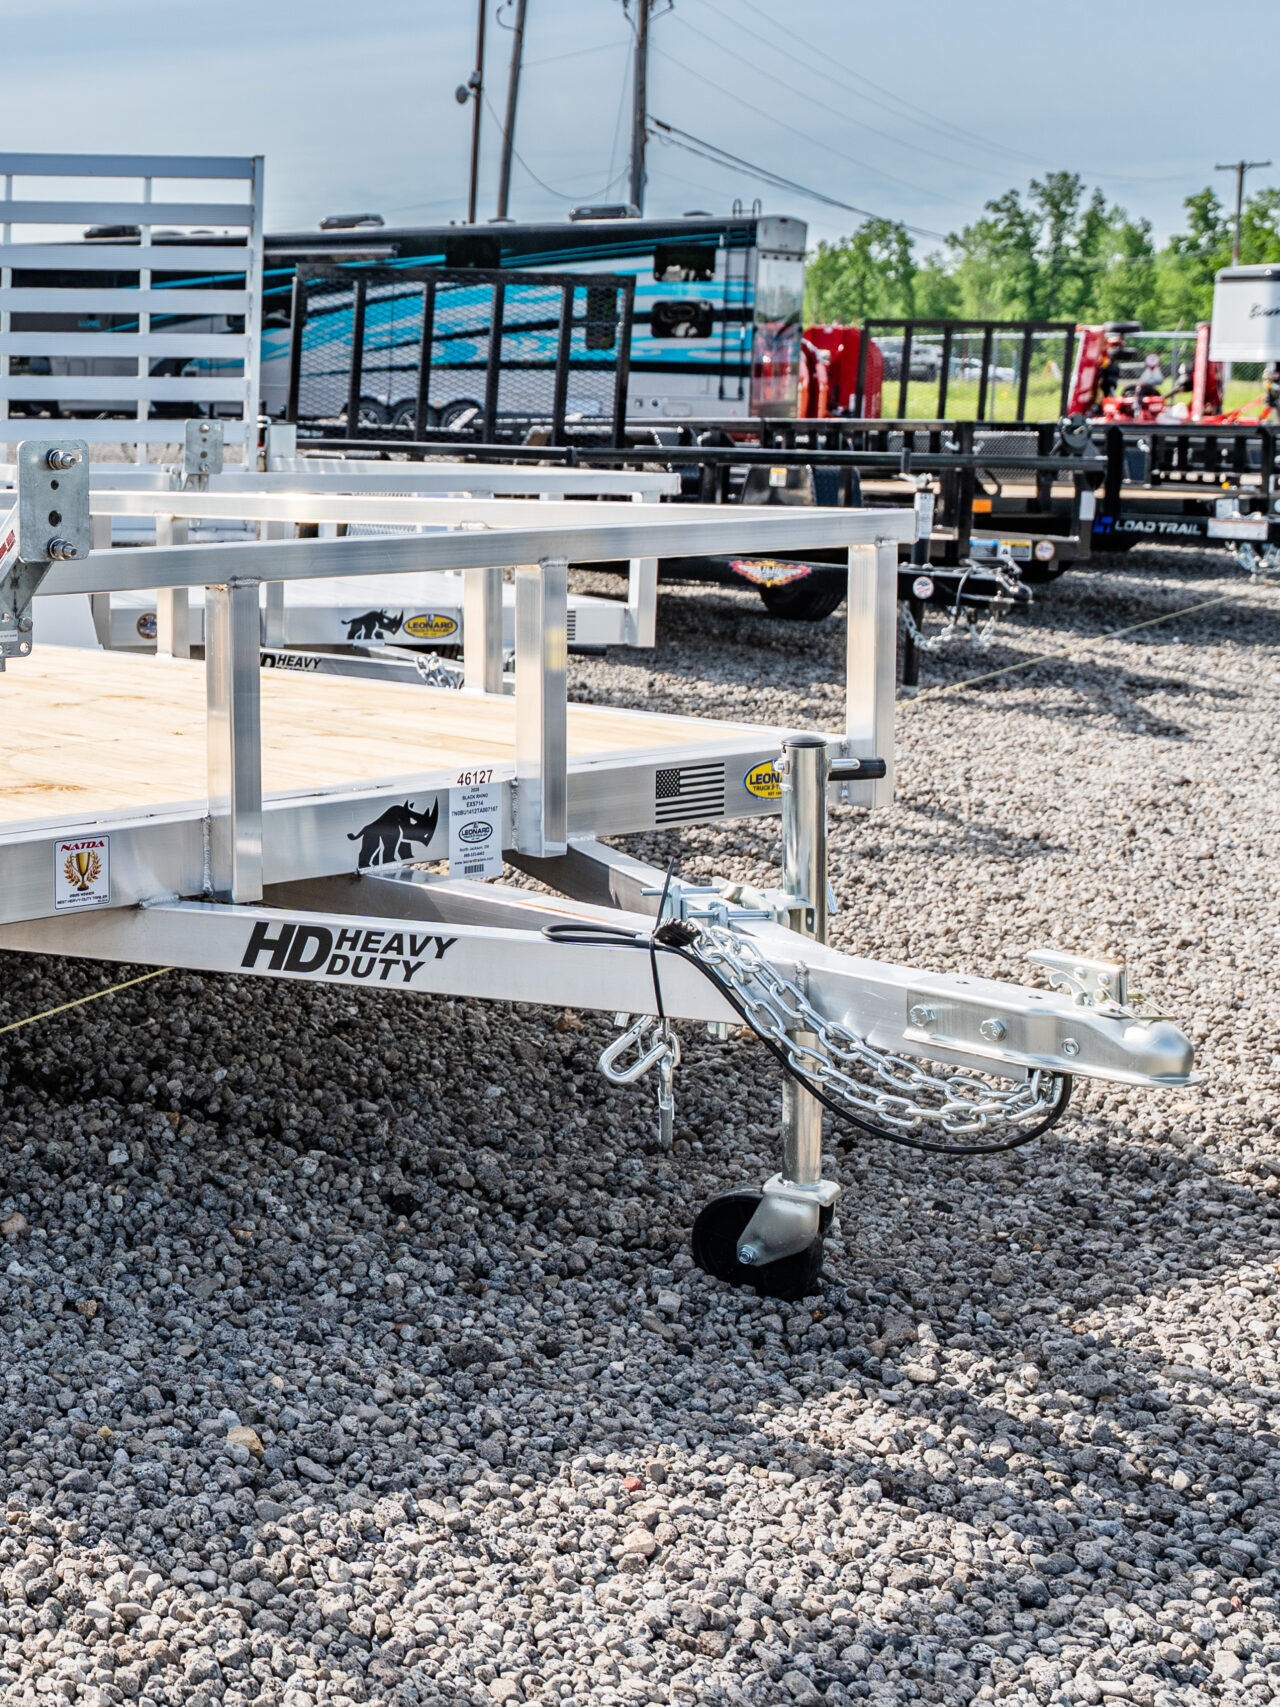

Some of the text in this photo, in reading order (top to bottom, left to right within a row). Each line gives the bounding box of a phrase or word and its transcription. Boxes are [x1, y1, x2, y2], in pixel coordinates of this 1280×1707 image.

[1114, 520, 1156, 533] LOAD
[1157, 522, 1202, 535] TRAIL
[407, 621, 453, 629] LEONARD
[277, 655, 321, 669] HEAVY
[457, 769, 493, 786] 46127
[749, 772, 782, 785] LEON
[462, 827, 490, 836] LEONARD
[61, 840, 104, 851] NATDA
[241, 921, 333, 973] HD
[335, 928, 459, 959] HEAVY
[326, 954, 426, 982] DUTY
